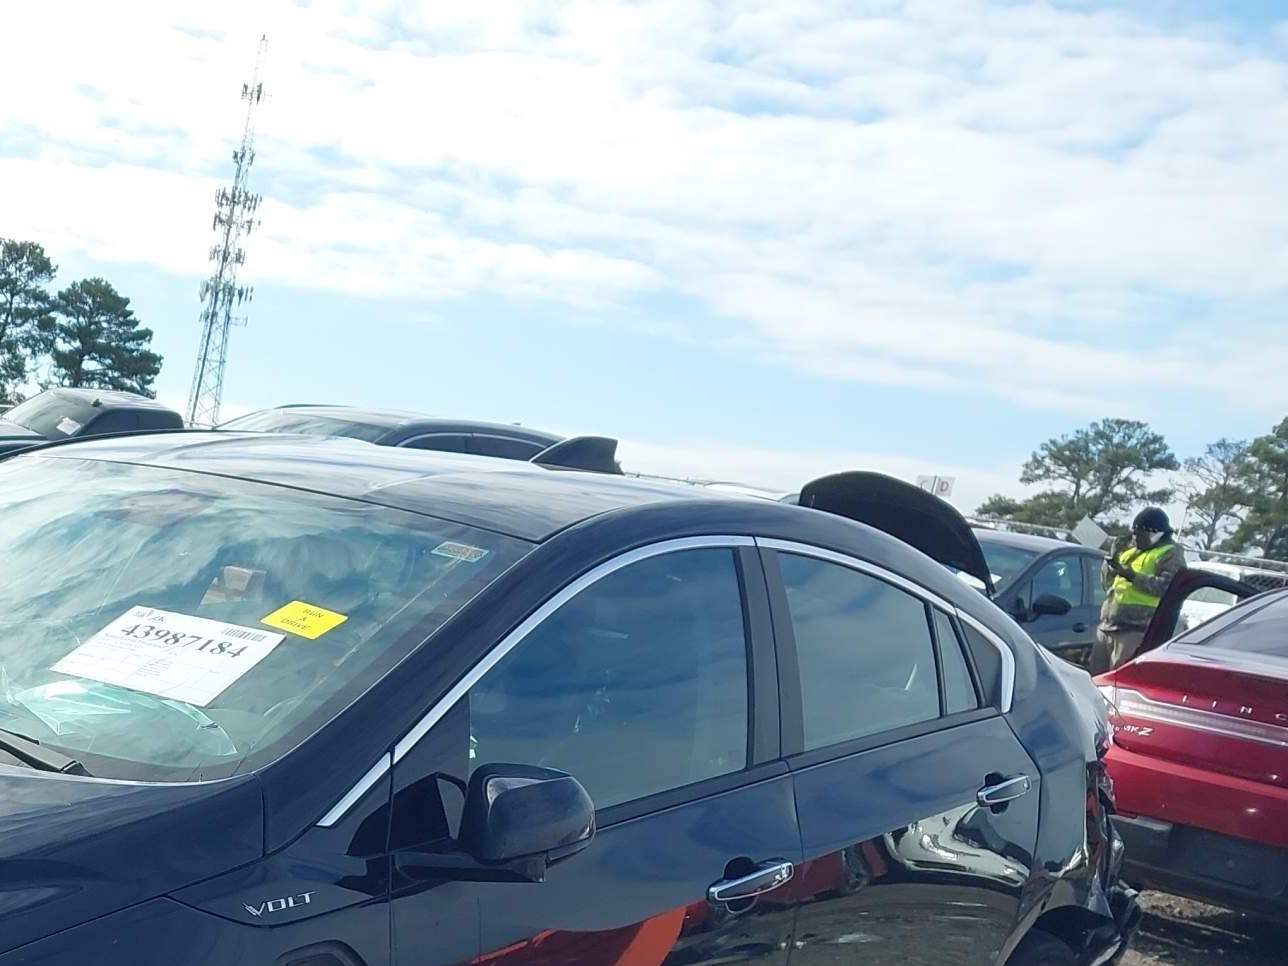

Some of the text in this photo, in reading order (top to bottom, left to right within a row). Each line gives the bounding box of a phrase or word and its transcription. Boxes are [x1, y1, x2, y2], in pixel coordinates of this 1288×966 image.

[302, 608, 324, 619] RUN
[280, 618, 311, 631] DRIVE
[121, 623, 249, 659] 43987184
[242, 890, 319, 918] VOLT
